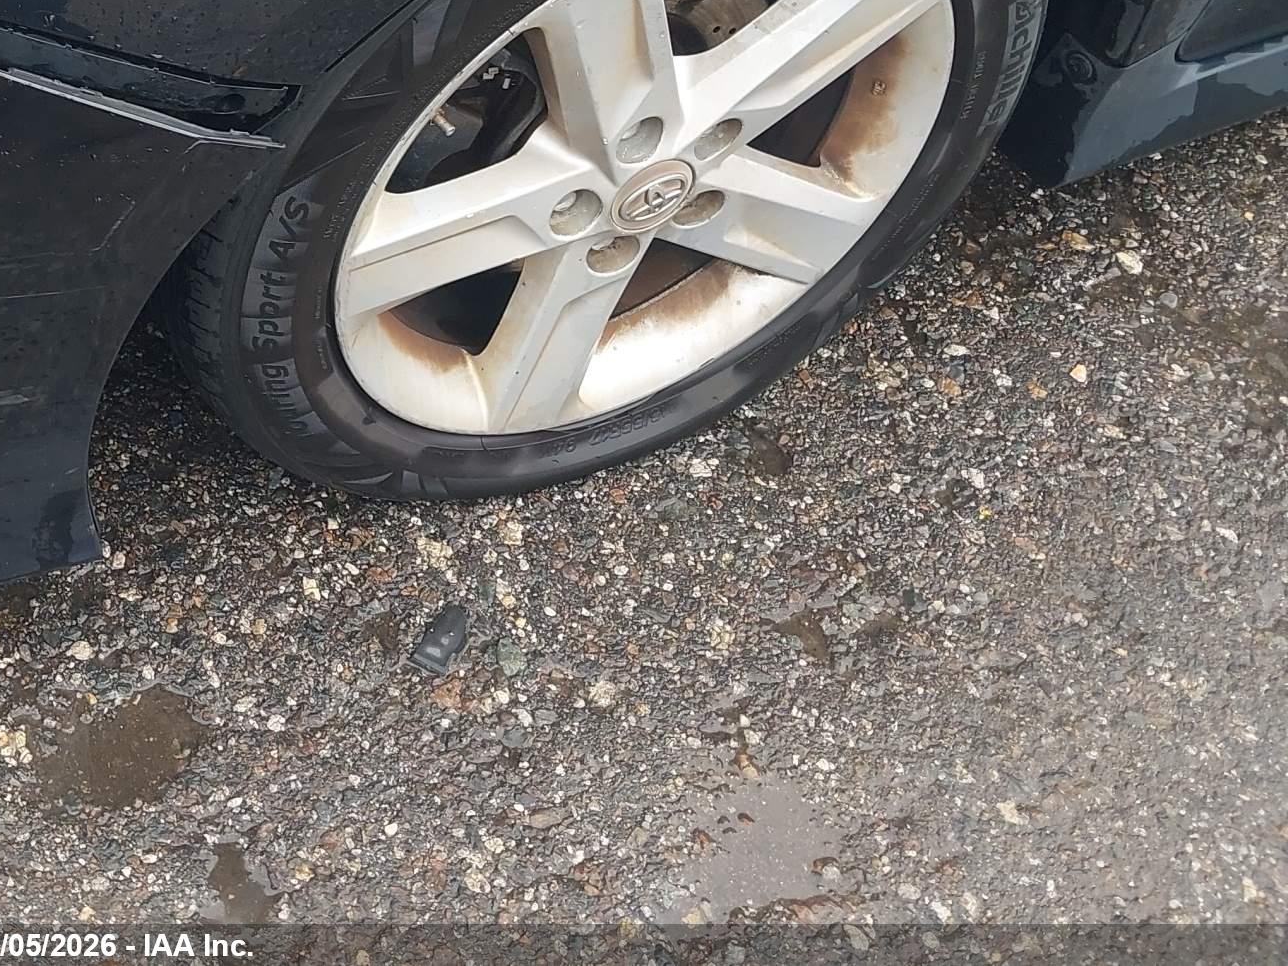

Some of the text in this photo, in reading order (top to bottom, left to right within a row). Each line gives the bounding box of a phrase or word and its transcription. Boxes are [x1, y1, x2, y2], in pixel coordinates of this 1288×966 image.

[987, 1, 1033, 128] Achille
[268, 195, 310, 260] A/S
[249, 269, 288, 352] Sport
